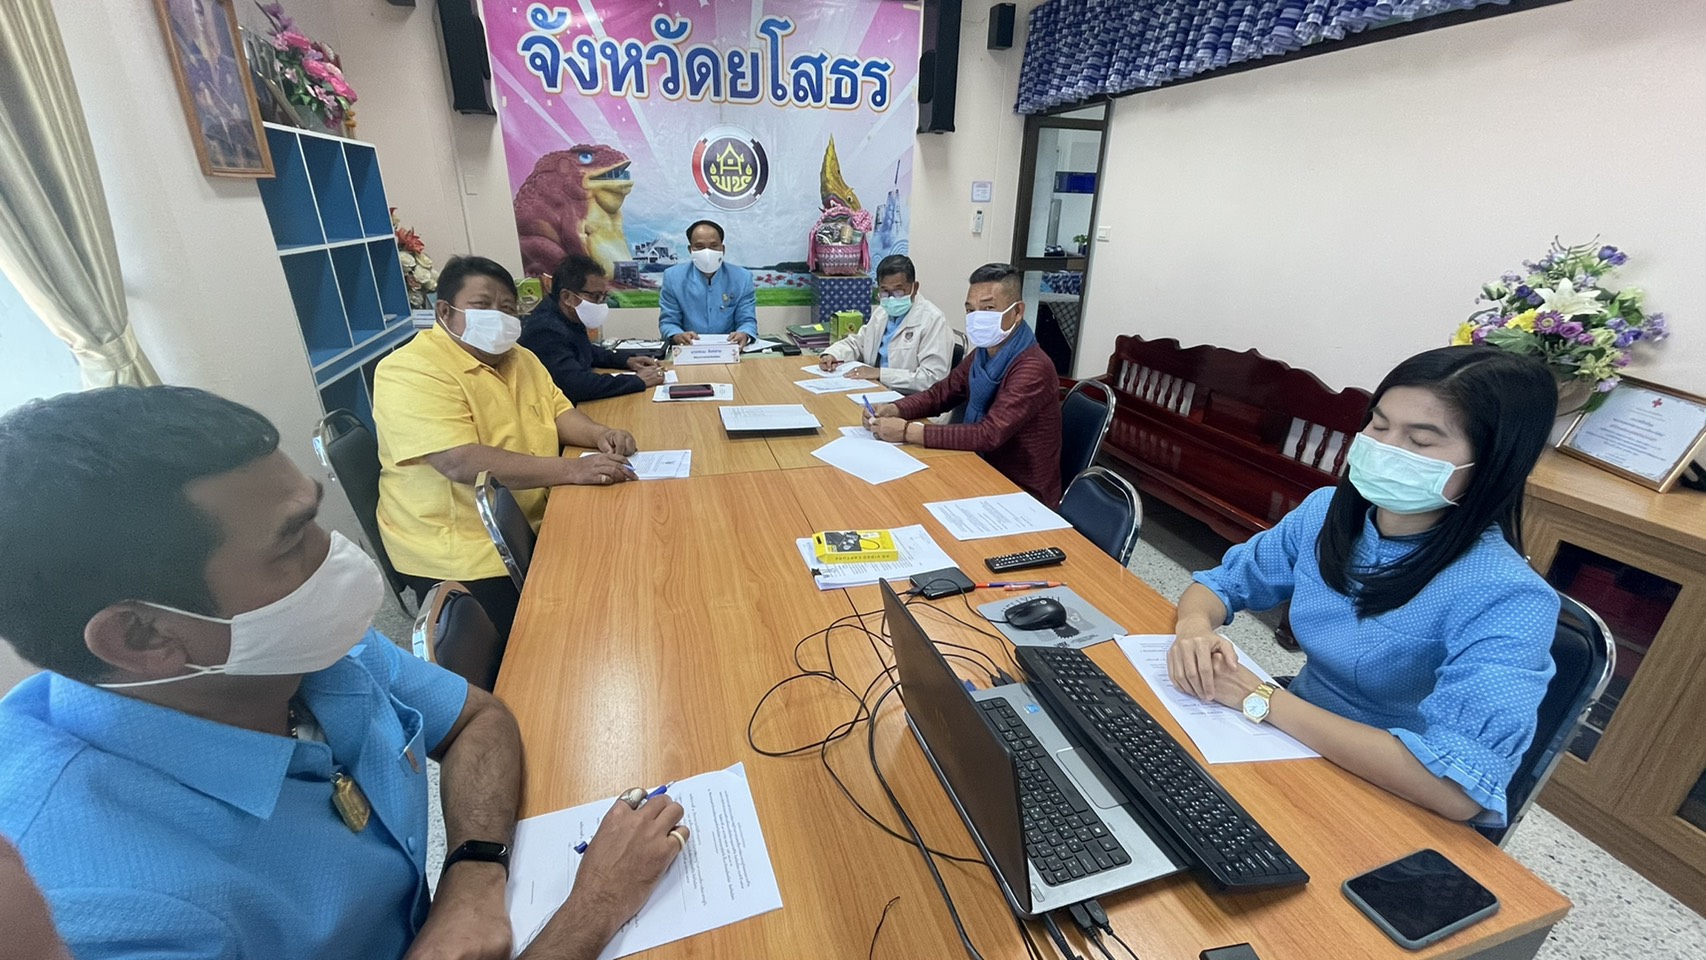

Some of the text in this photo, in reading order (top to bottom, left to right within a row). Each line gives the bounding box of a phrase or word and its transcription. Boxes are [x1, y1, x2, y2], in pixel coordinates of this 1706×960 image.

[520, 5, 893, 109] จังหวัดยโสธร
